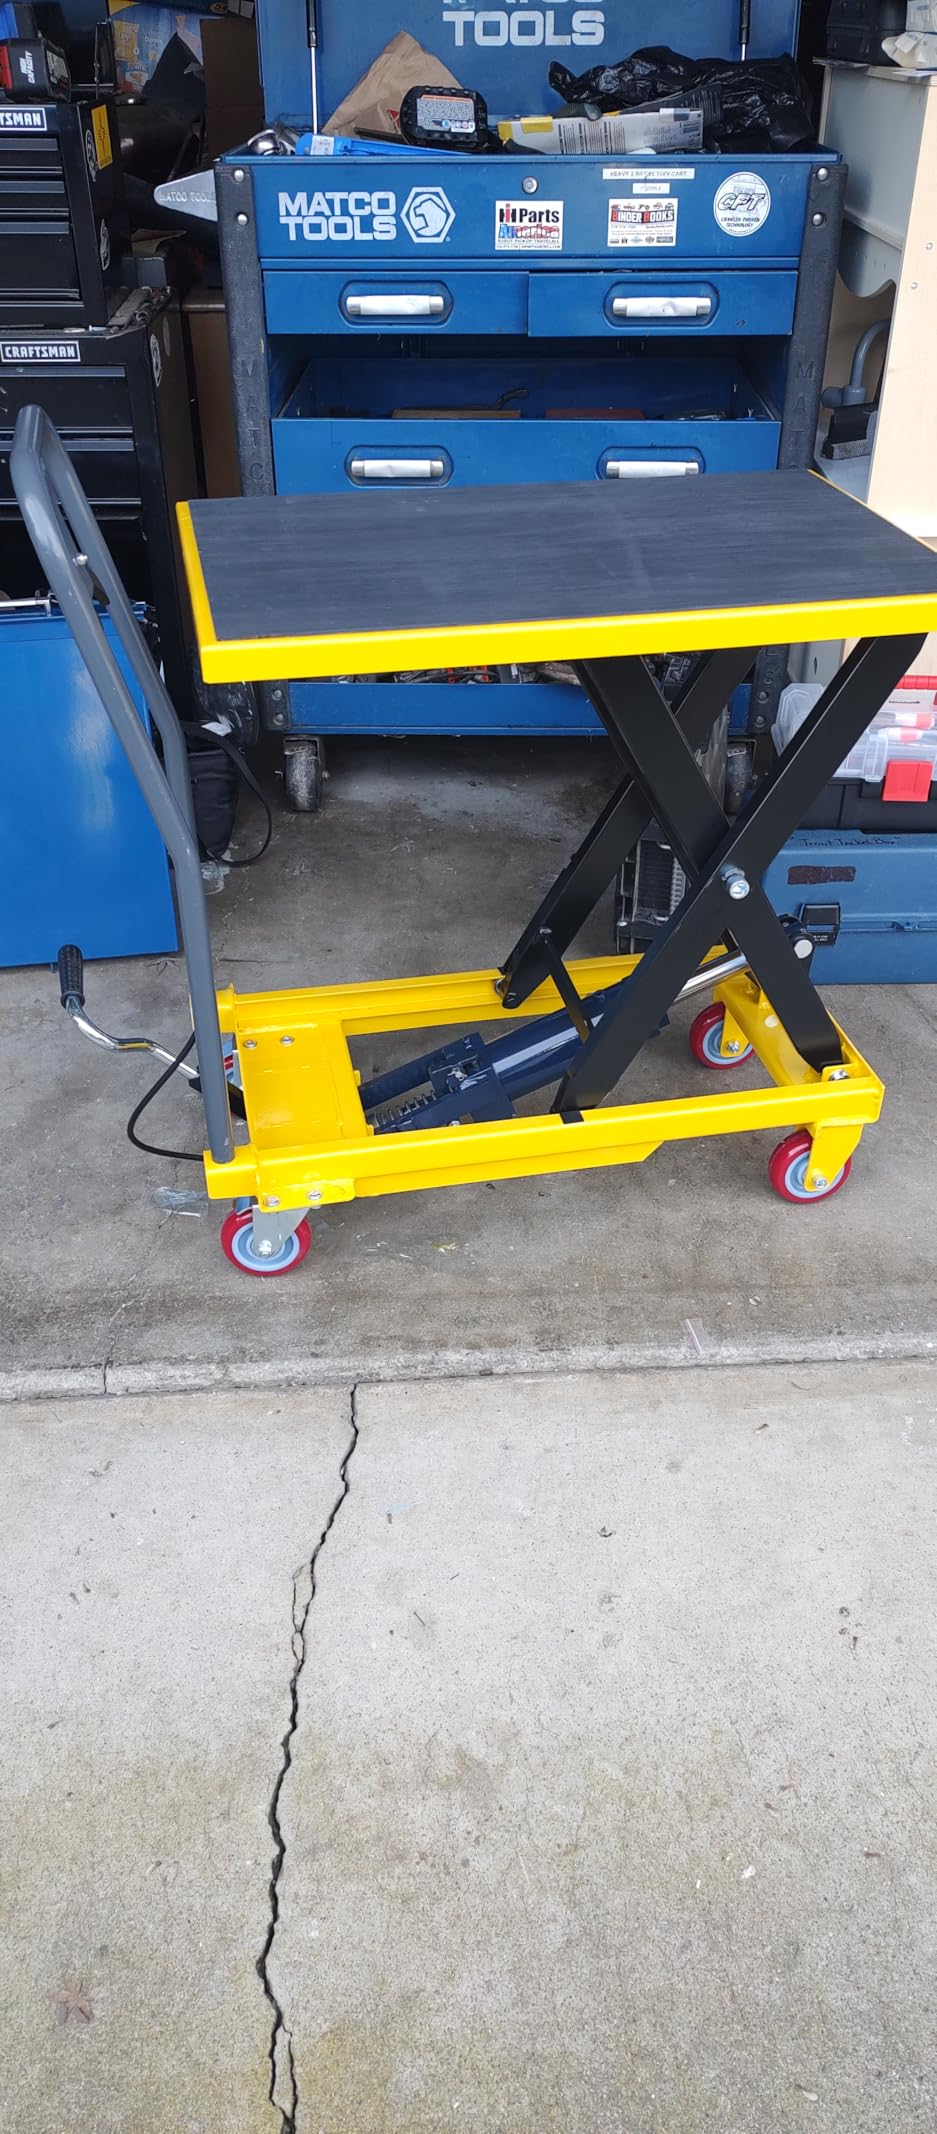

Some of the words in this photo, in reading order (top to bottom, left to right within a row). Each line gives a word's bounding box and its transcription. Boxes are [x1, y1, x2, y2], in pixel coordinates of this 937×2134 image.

[443, 10, 605, 46] TOOLS
[25, 50, 36, 84] CAPACITY
[0, 112, 42, 126] TSMAN
[278, 191, 396, 216] MATCO
[519, 208, 560, 223] Parts
[612, 210, 642, 223] BINDER
[643, 210, 674, 223] BOOKS
[279, 216, 397, 240] TOOLS
[498, 223, 560, 239] America
[4, 345, 76, 358] CRAFTSMAN
